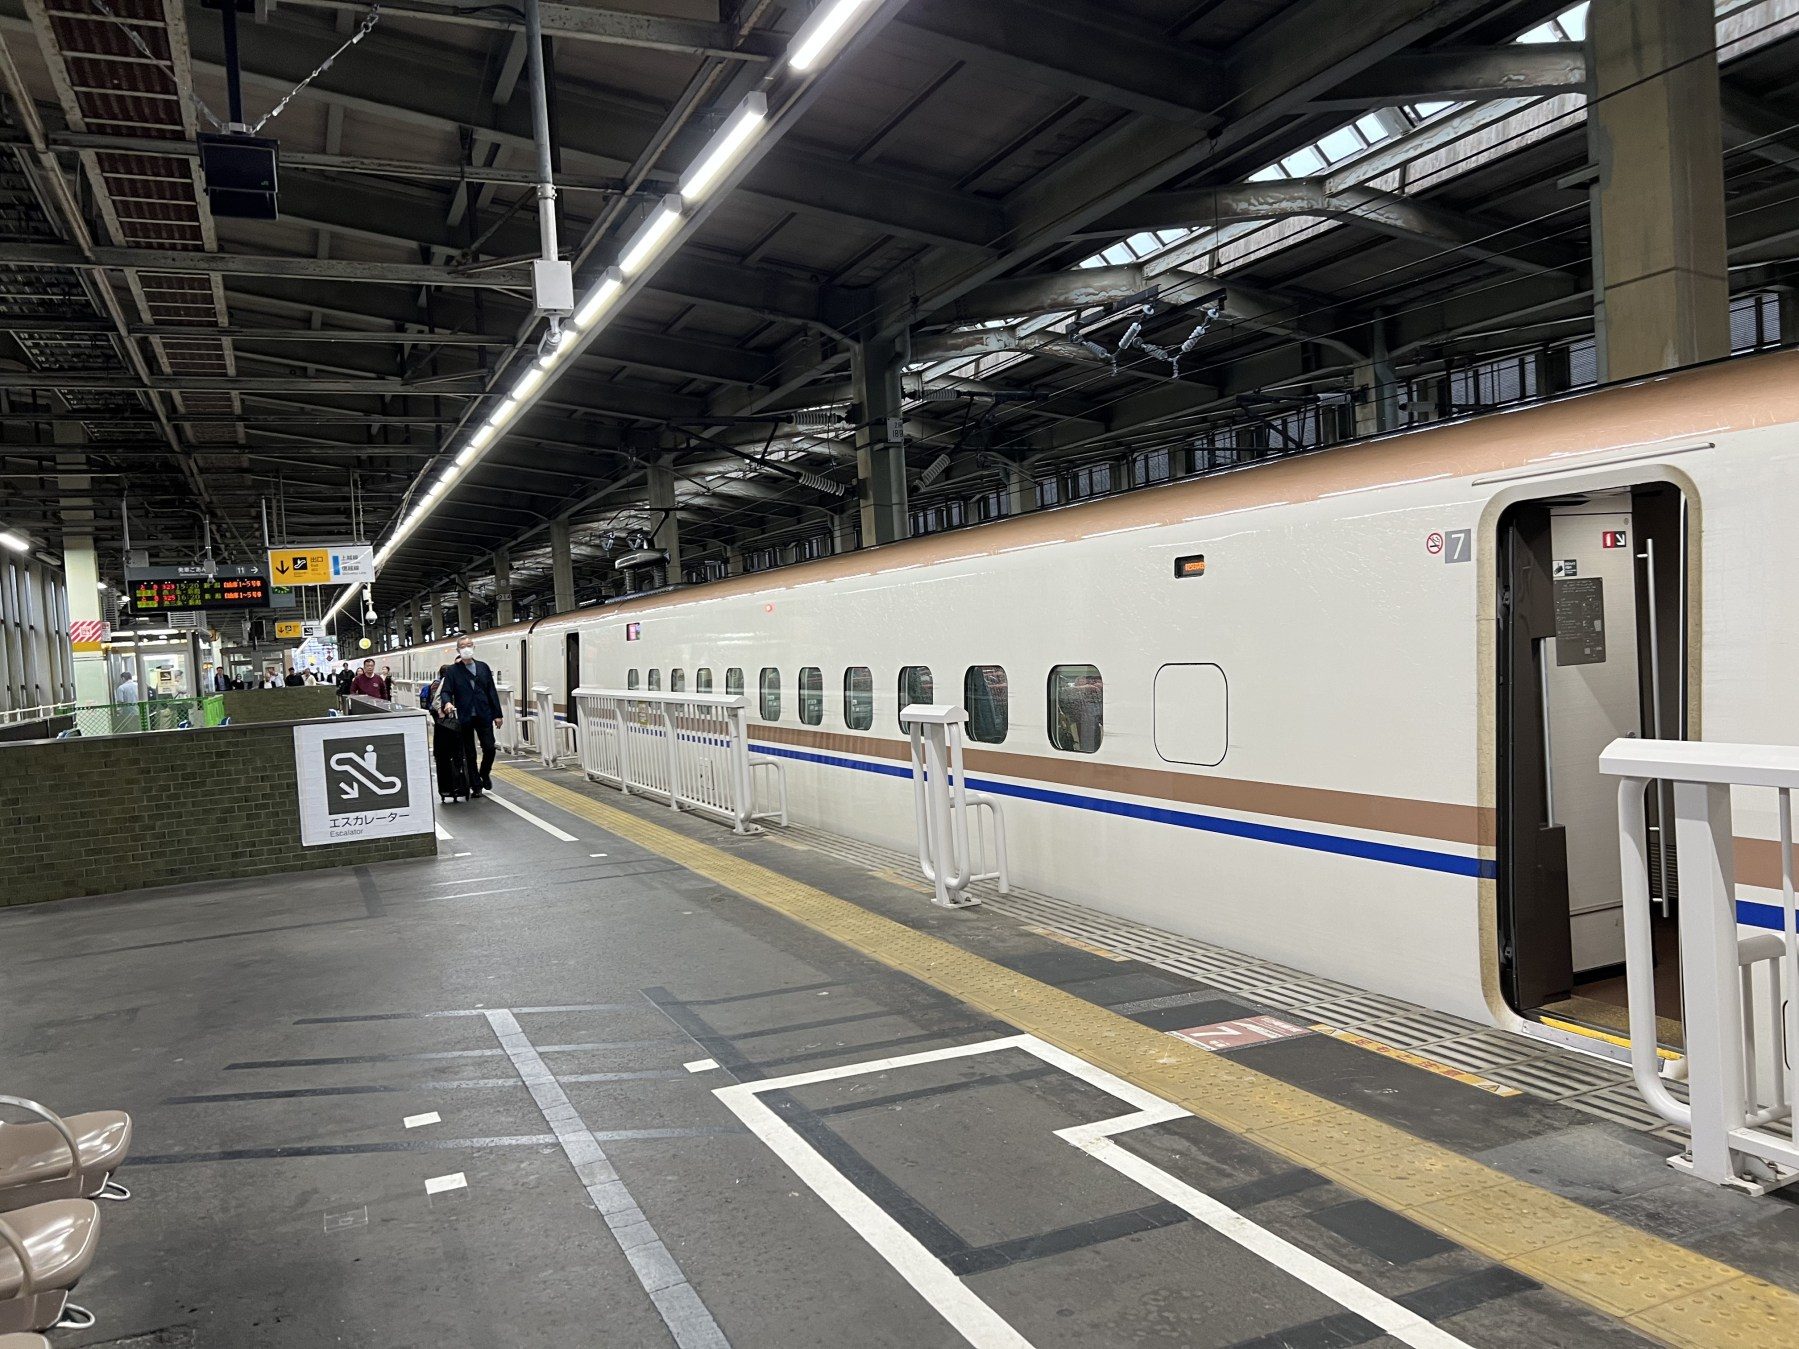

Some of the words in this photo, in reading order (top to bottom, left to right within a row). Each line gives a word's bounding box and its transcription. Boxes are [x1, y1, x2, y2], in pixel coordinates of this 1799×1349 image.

[1451, 533, 1465, 560] 7
[329, 812, 410, 829] エスカレーター
[329, 829, 364, 838] Escalator
